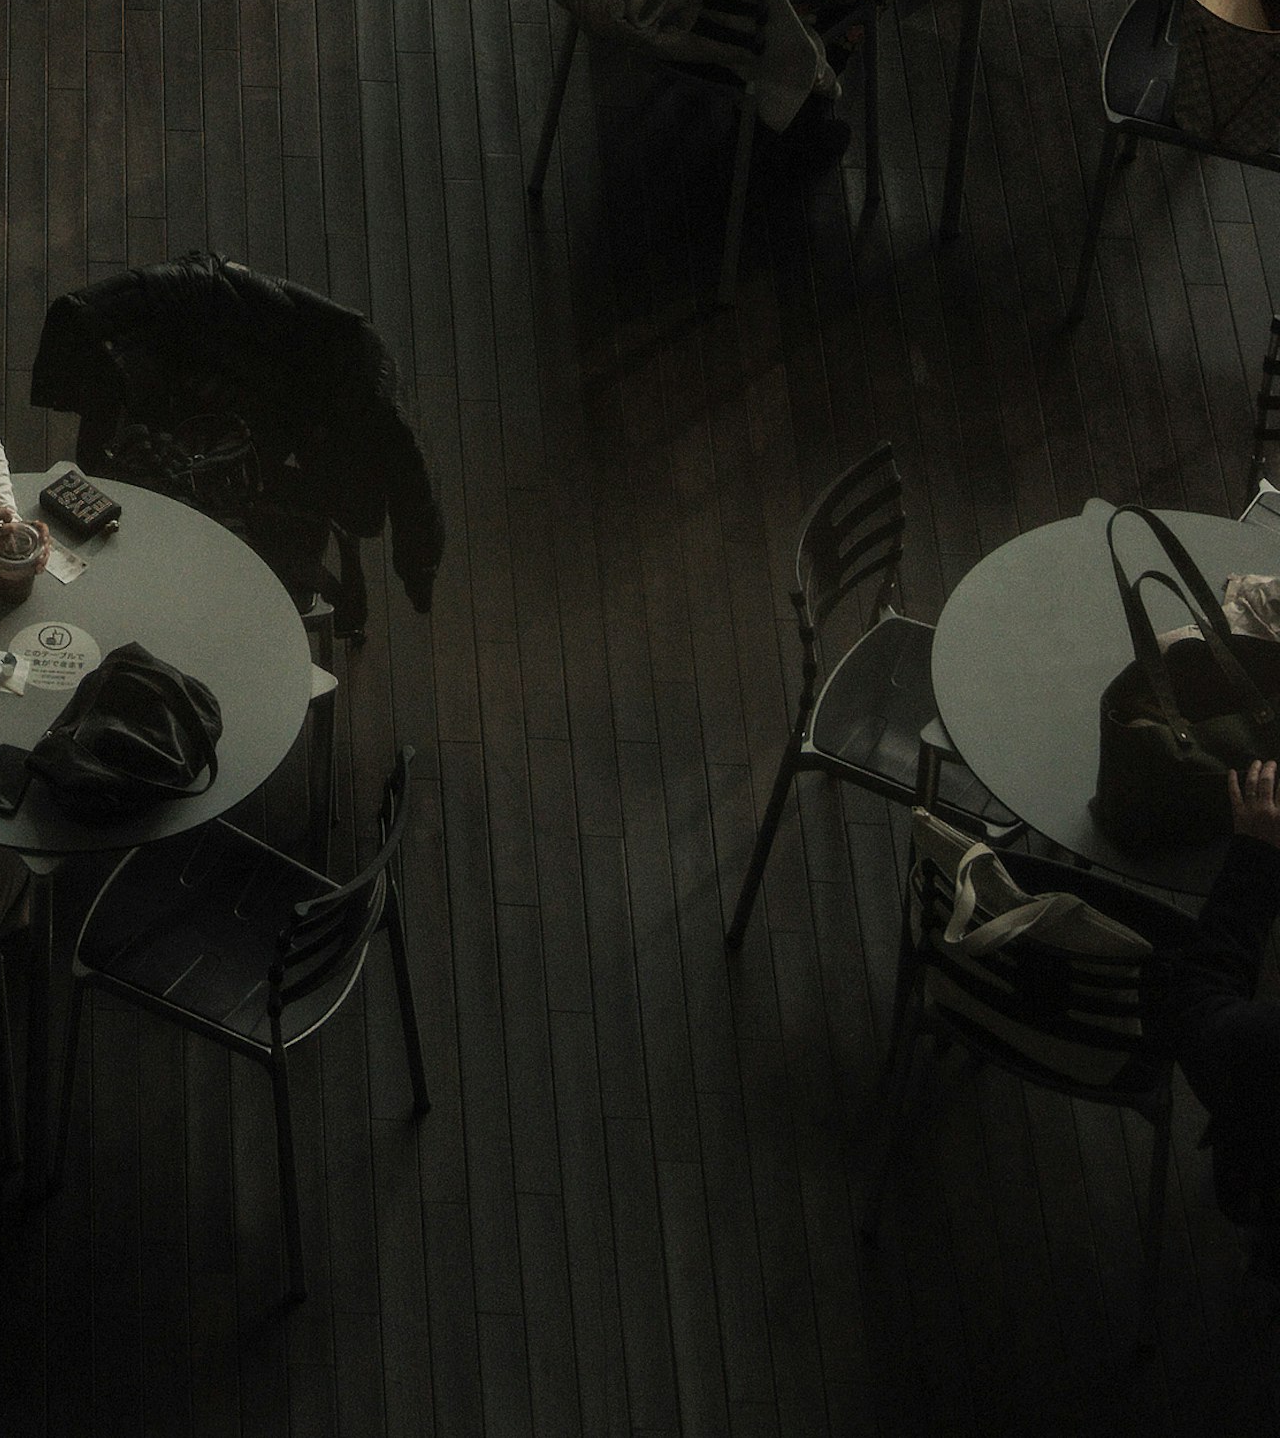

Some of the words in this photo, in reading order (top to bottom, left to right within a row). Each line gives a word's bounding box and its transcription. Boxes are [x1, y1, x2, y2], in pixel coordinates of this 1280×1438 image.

[23, 649, 85, 662] このテーブルで
